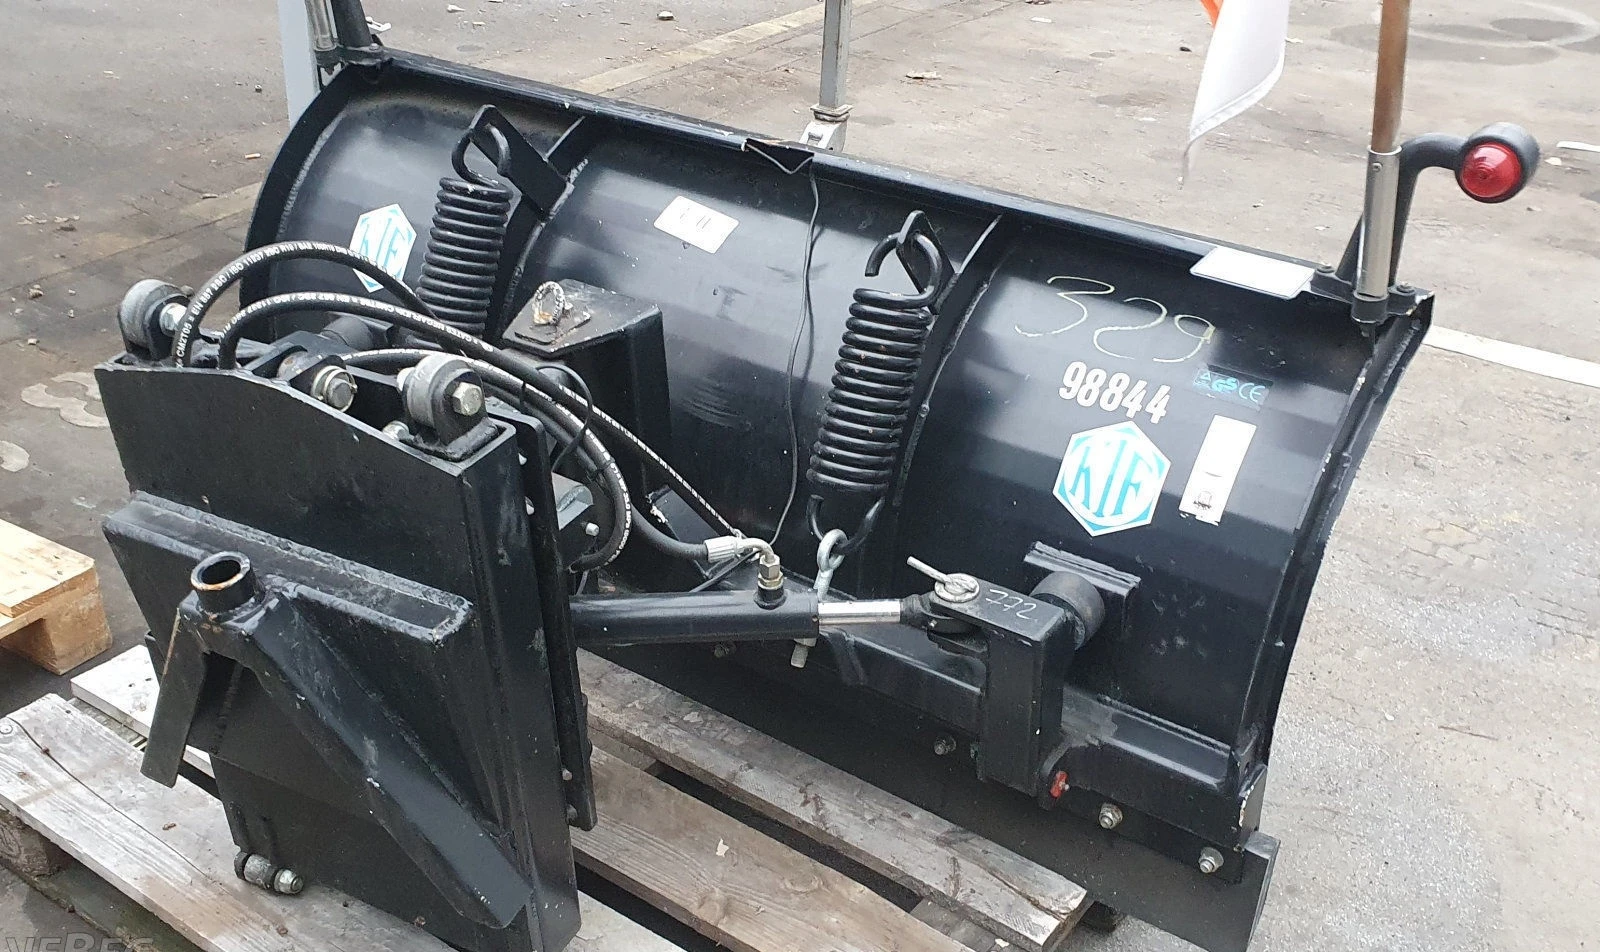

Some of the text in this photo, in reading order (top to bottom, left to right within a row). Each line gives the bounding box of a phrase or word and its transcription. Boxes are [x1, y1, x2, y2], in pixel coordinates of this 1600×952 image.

[1015, 276, 1215, 362] 329
[1058, 361, 1170, 424] 98844
[985, 588, 1037, 620] 772
